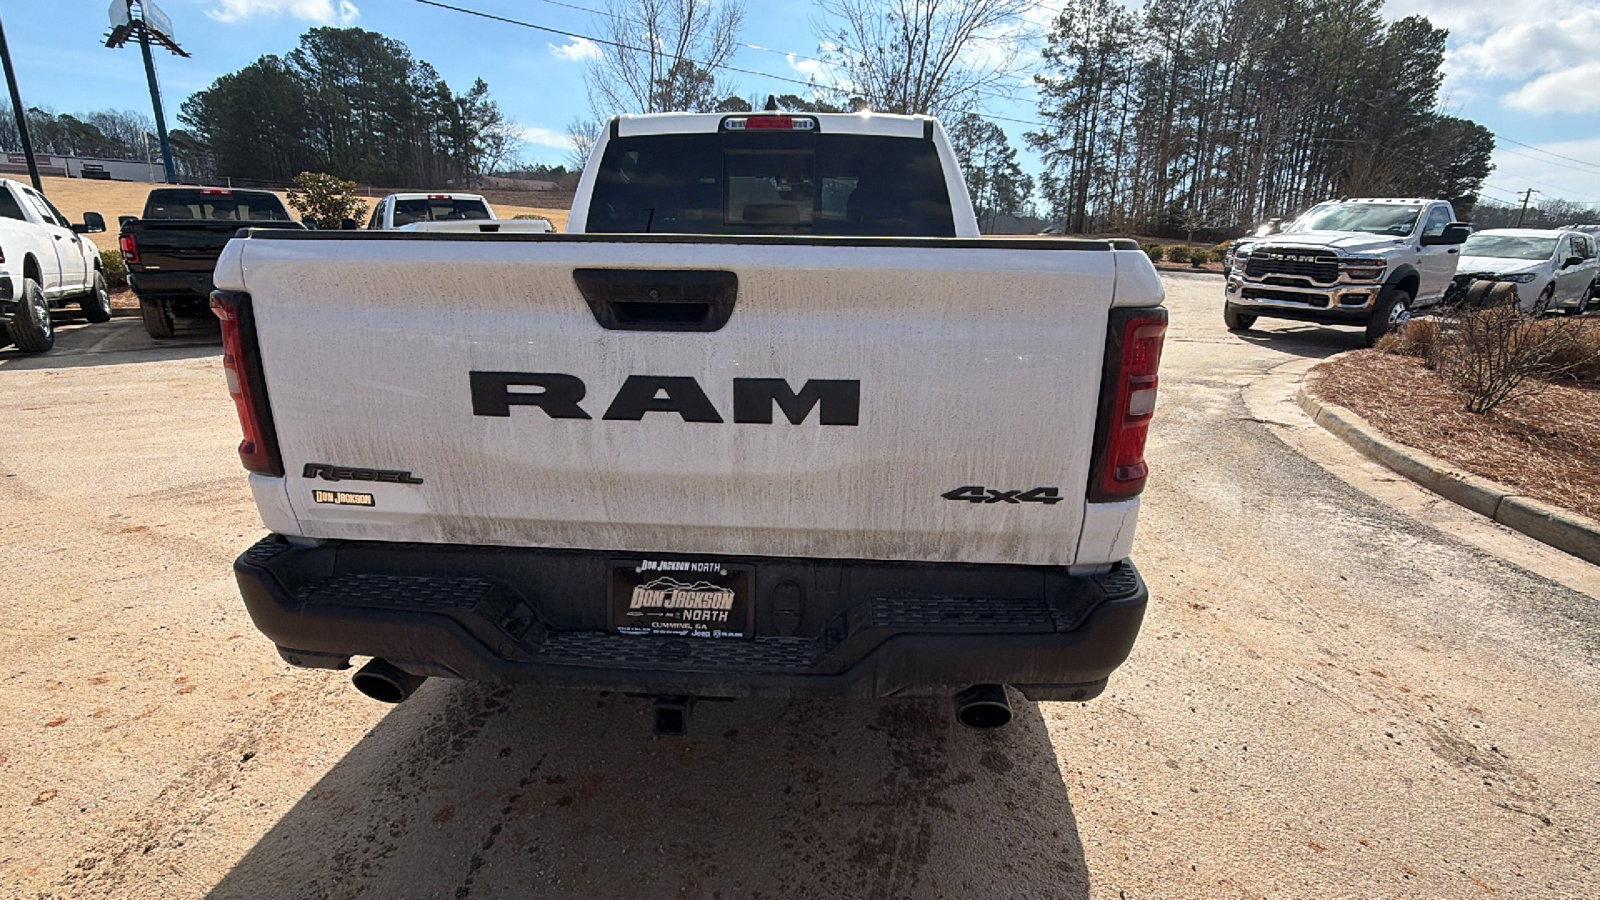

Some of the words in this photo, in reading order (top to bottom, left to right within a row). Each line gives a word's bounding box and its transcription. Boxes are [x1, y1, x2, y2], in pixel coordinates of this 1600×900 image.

[1271, 254, 1313, 262] RAM
[469, 371, 861, 426] RAM
[302, 463, 424, 485] REBEL
[335, 491, 371, 505] JACKSON
[940, 486, 1064, 505] 4x4
[691, 563, 720, 571] NORTH
[629, 587, 665, 609] DON
[664, 589, 735, 610] JACKSON
[683, 610, 728, 621] NORTH
